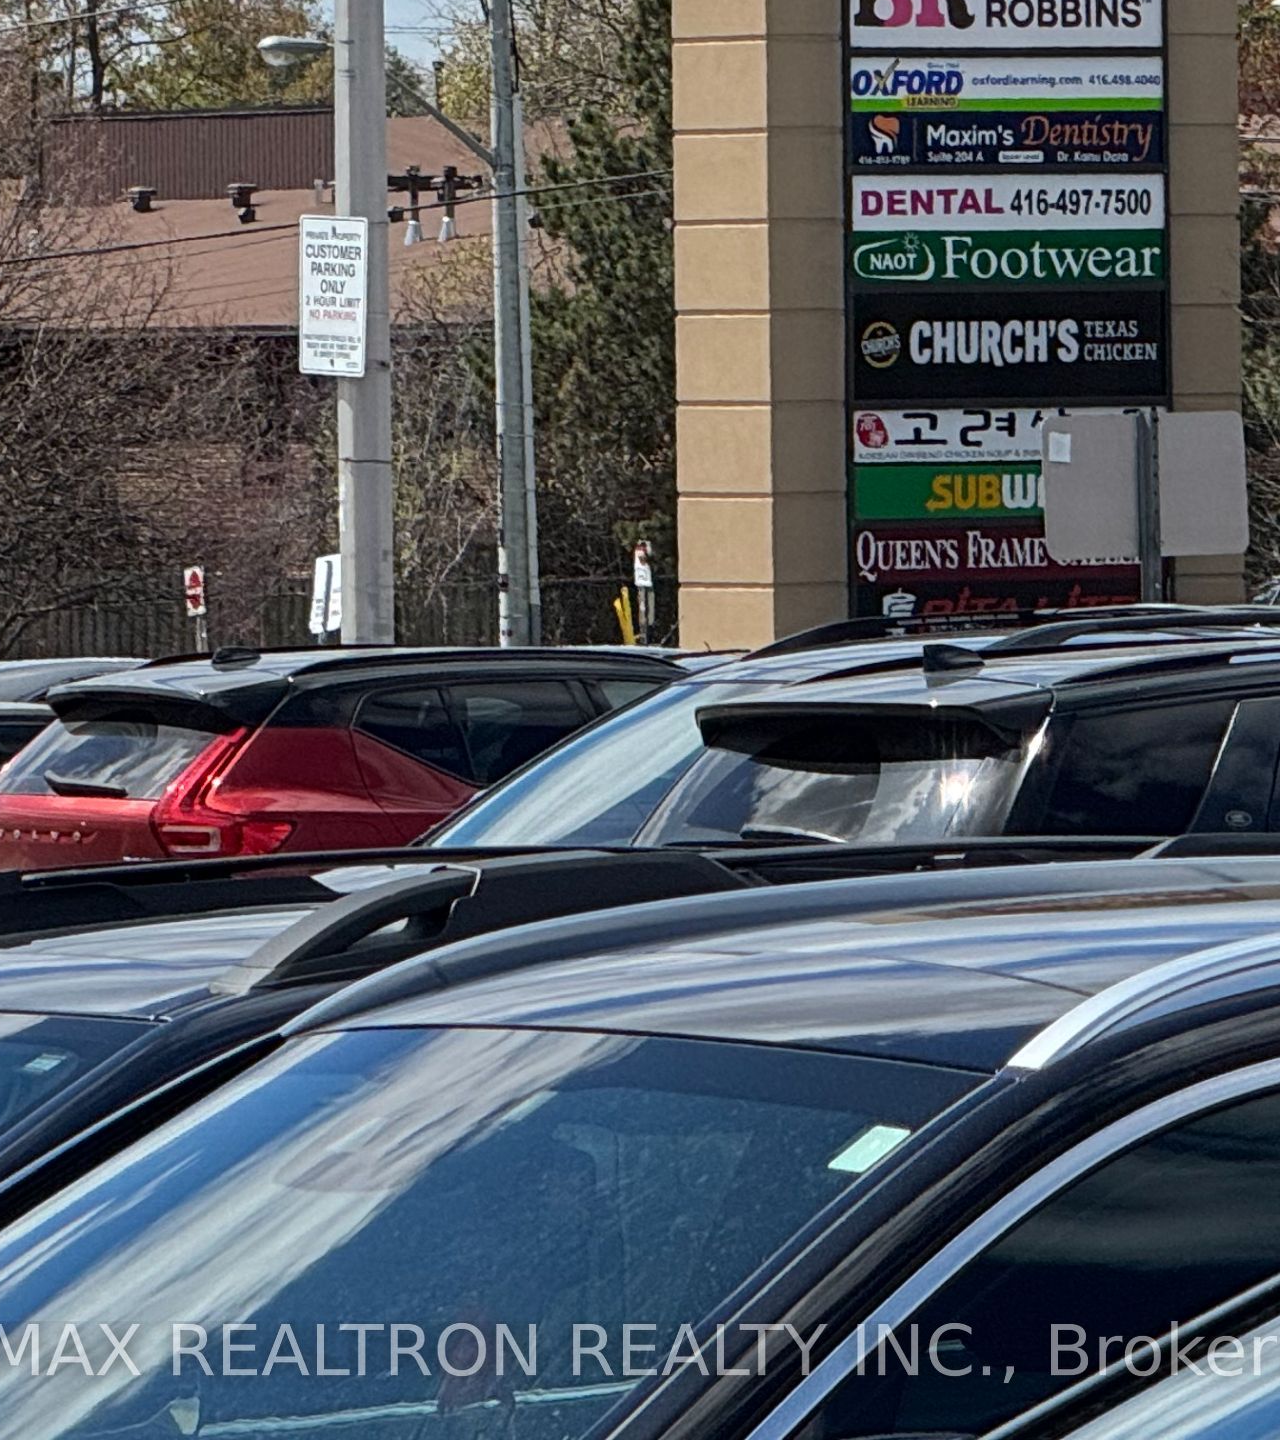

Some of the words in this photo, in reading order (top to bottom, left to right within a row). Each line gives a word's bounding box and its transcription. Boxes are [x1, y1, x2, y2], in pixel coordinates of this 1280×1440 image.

[852, 58, 964, 96] OXFORD
[971, 73, 1083, 87] oxfordlearning.com
[906, 97, 956, 106] LEARNING
[927, 124, 1014, 147] Maxim's
[1021, 114, 1153, 161] Dentistry
[861, 188, 1005, 216] DENTAL
[305, 244, 361, 260] CUSTOMER
[940, 236, 1161, 279] Footwear
[311, 261, 355, 277] PARKING
[869, 253, 918, 270] NAOT
[320, 278, 346, 294] ONLY
[314, 296, 336, 307] HOUR
[1083, 320, 1138, 338] TEXAS
[910, 320, 1079, 366] CHURCH'S
[1083, 343, 1158, 361] CHICKEN
[856, 530, 958, 582] QUEEN'S
